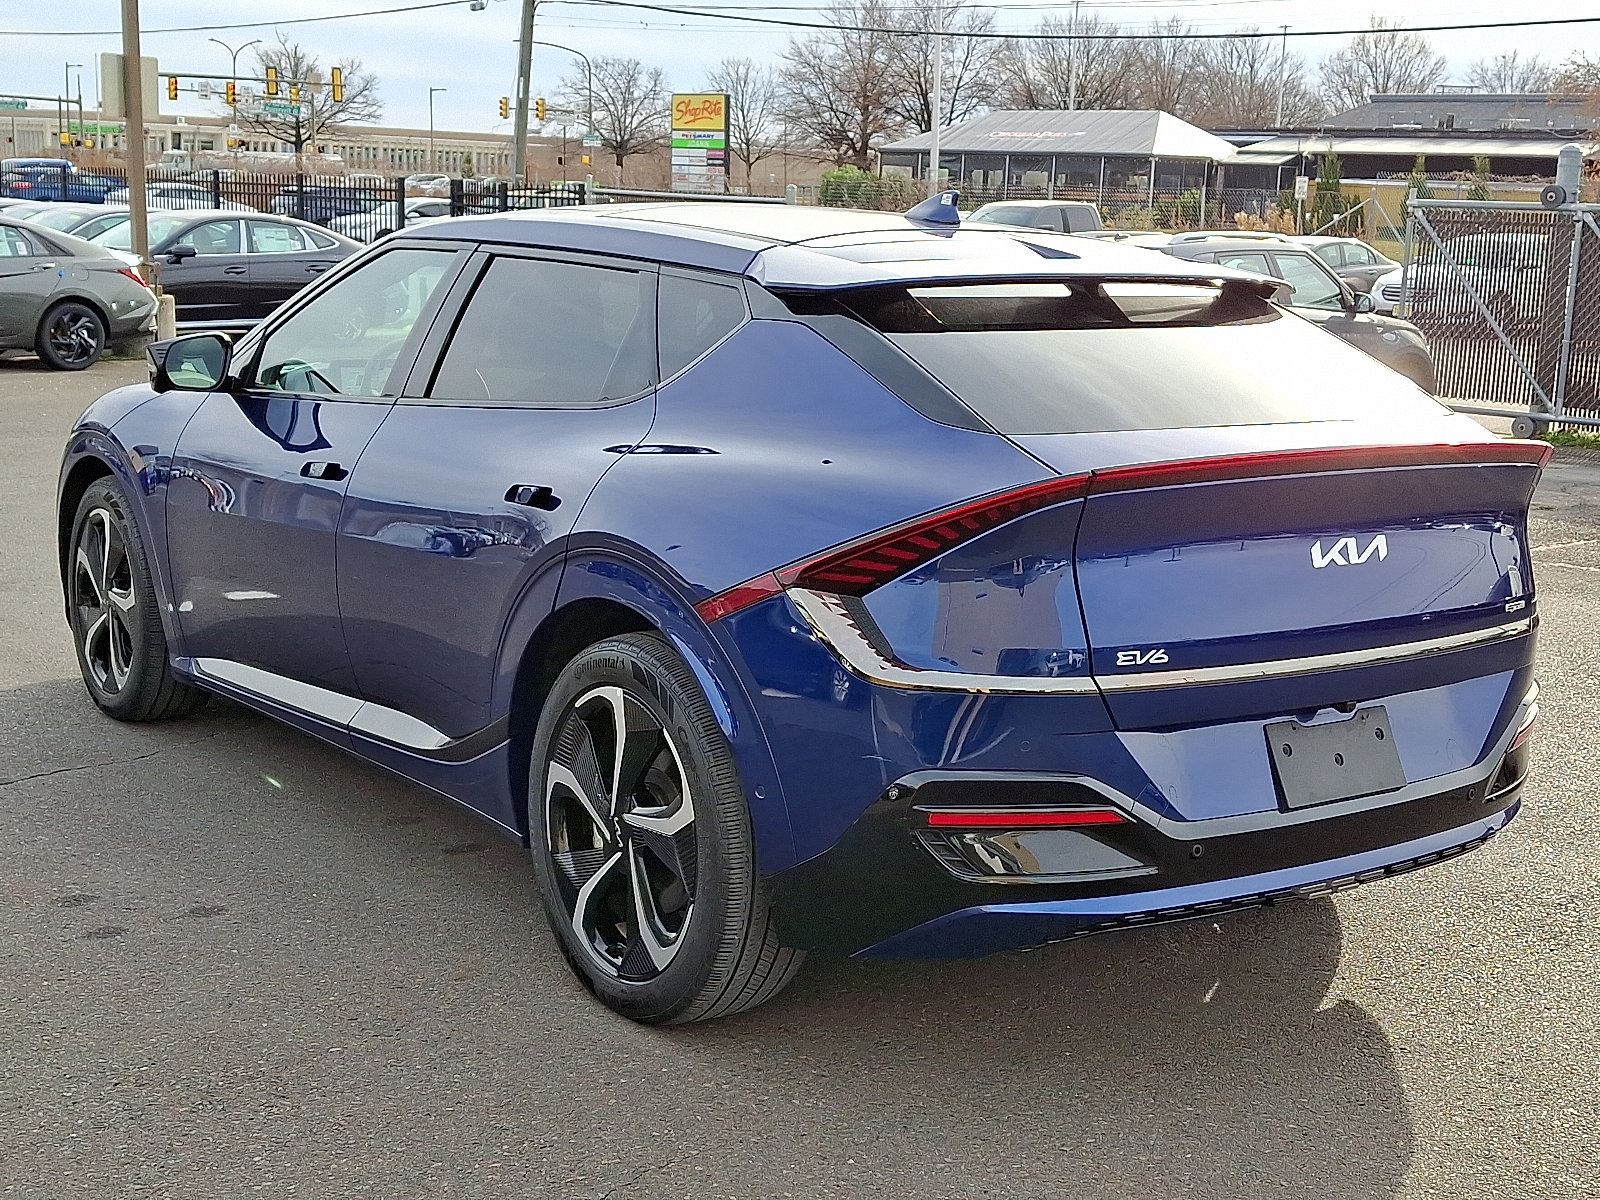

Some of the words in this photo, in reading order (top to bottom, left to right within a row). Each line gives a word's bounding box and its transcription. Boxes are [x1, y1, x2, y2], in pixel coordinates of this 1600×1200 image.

[675, 99, 722, 122] ShopRite
[1310, 533, 1389, 569] KIA
[575, 655, 620, 680] Continental
[1116, 648, 1169, 667] EV6
